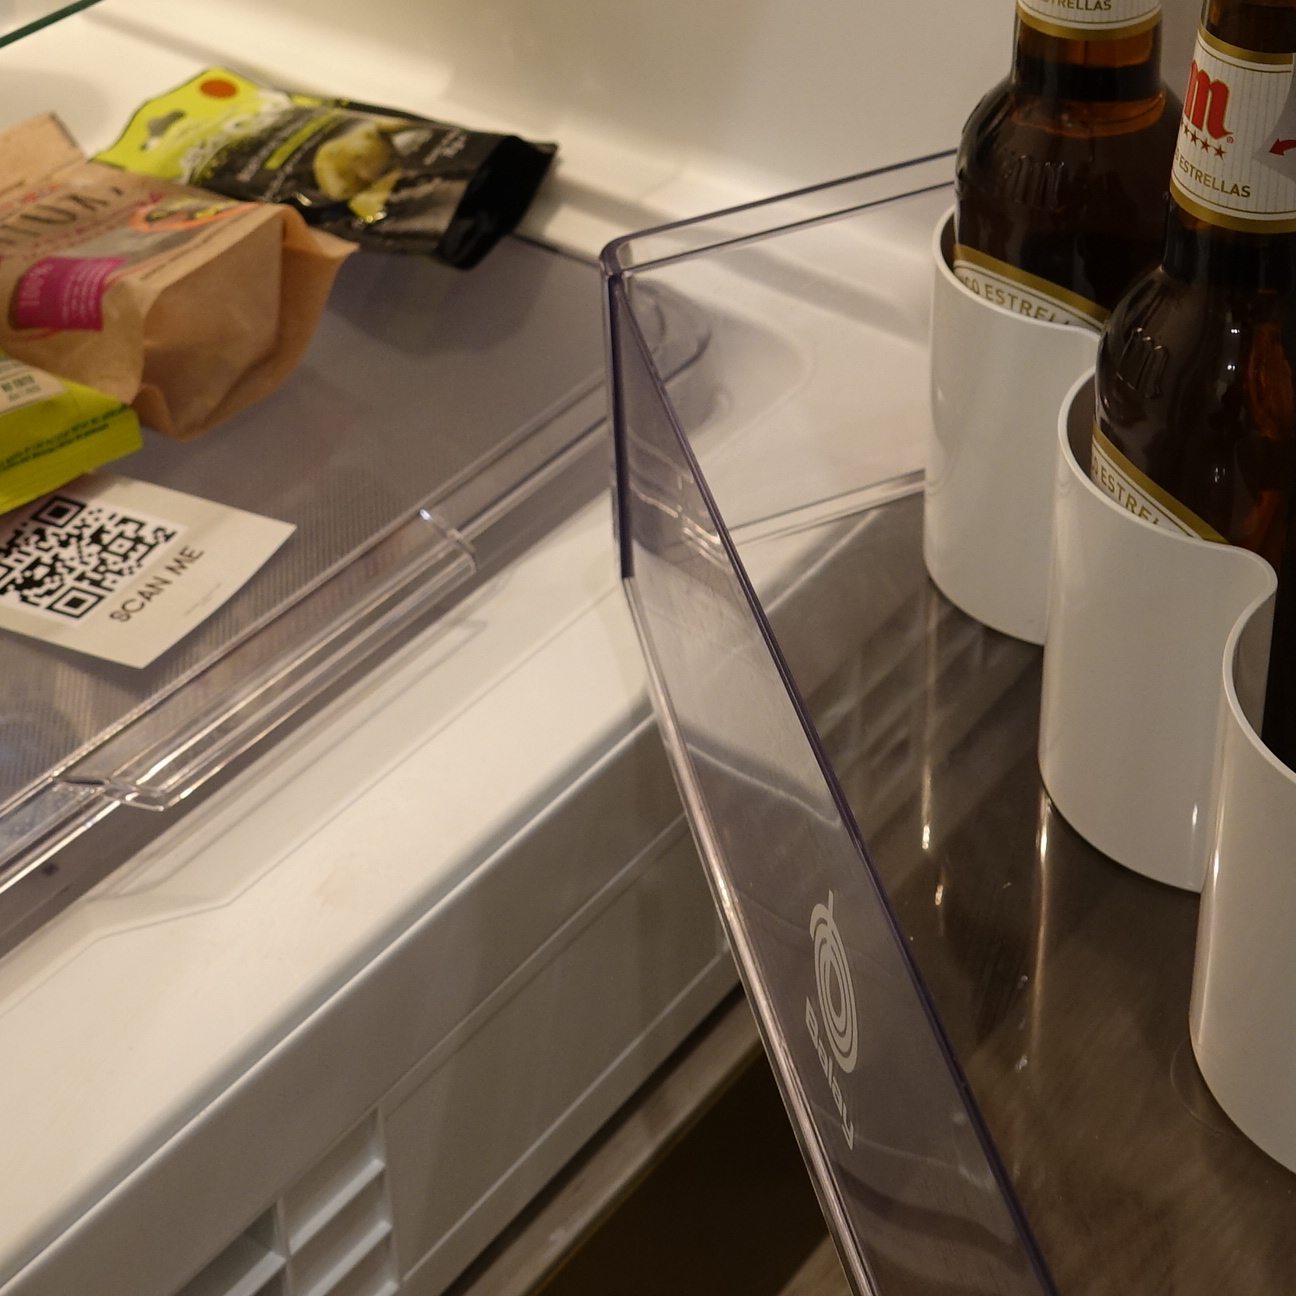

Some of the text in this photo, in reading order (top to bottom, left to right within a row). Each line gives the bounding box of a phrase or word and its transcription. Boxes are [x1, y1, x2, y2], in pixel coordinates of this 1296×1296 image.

[1178, 156, 1252, 199] ESTRELLAS
[108, 578, 170, 623] SCAN
[165, 544, 207, 579] ME
[805, 995, 854, 1151] Balay
